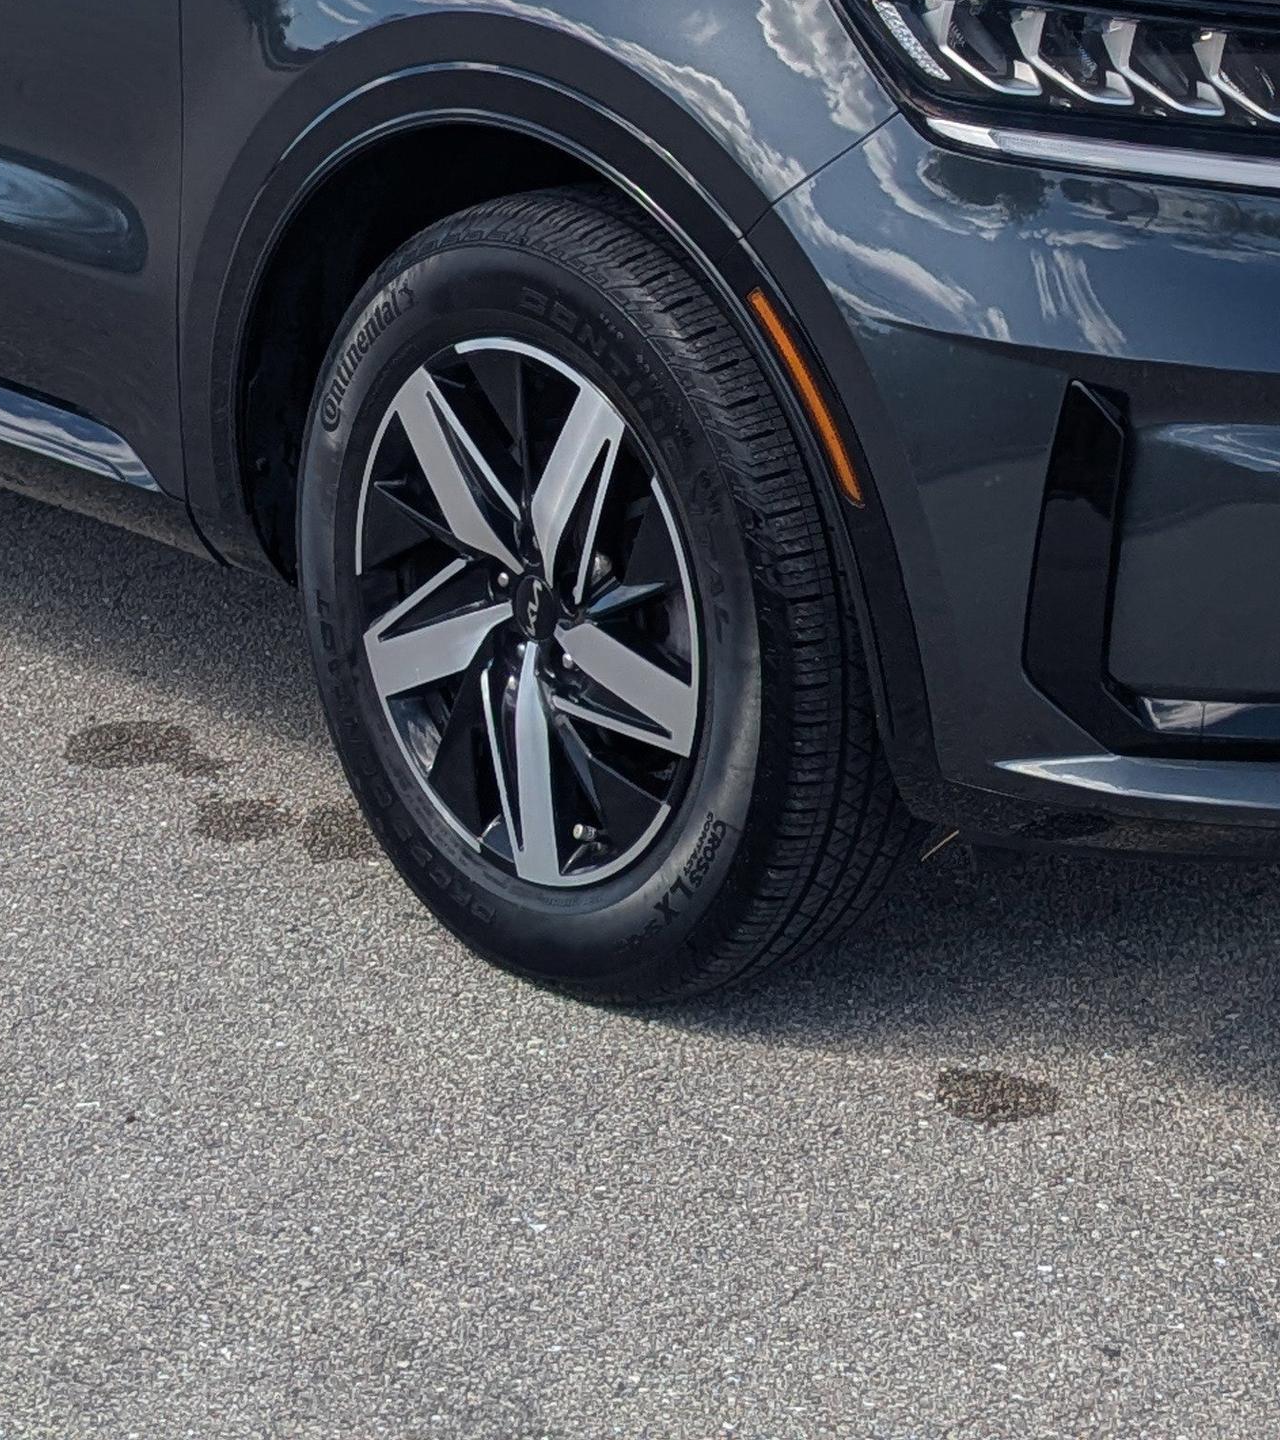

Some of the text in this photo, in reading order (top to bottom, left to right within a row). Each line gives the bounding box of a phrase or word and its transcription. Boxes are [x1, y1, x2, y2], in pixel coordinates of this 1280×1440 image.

[320, 288, 403, 433] Continental
[526, 579, 543, 637] KIA
[689, 819, 727, 889] CROSS
[652, 874, 695, 926] LX
